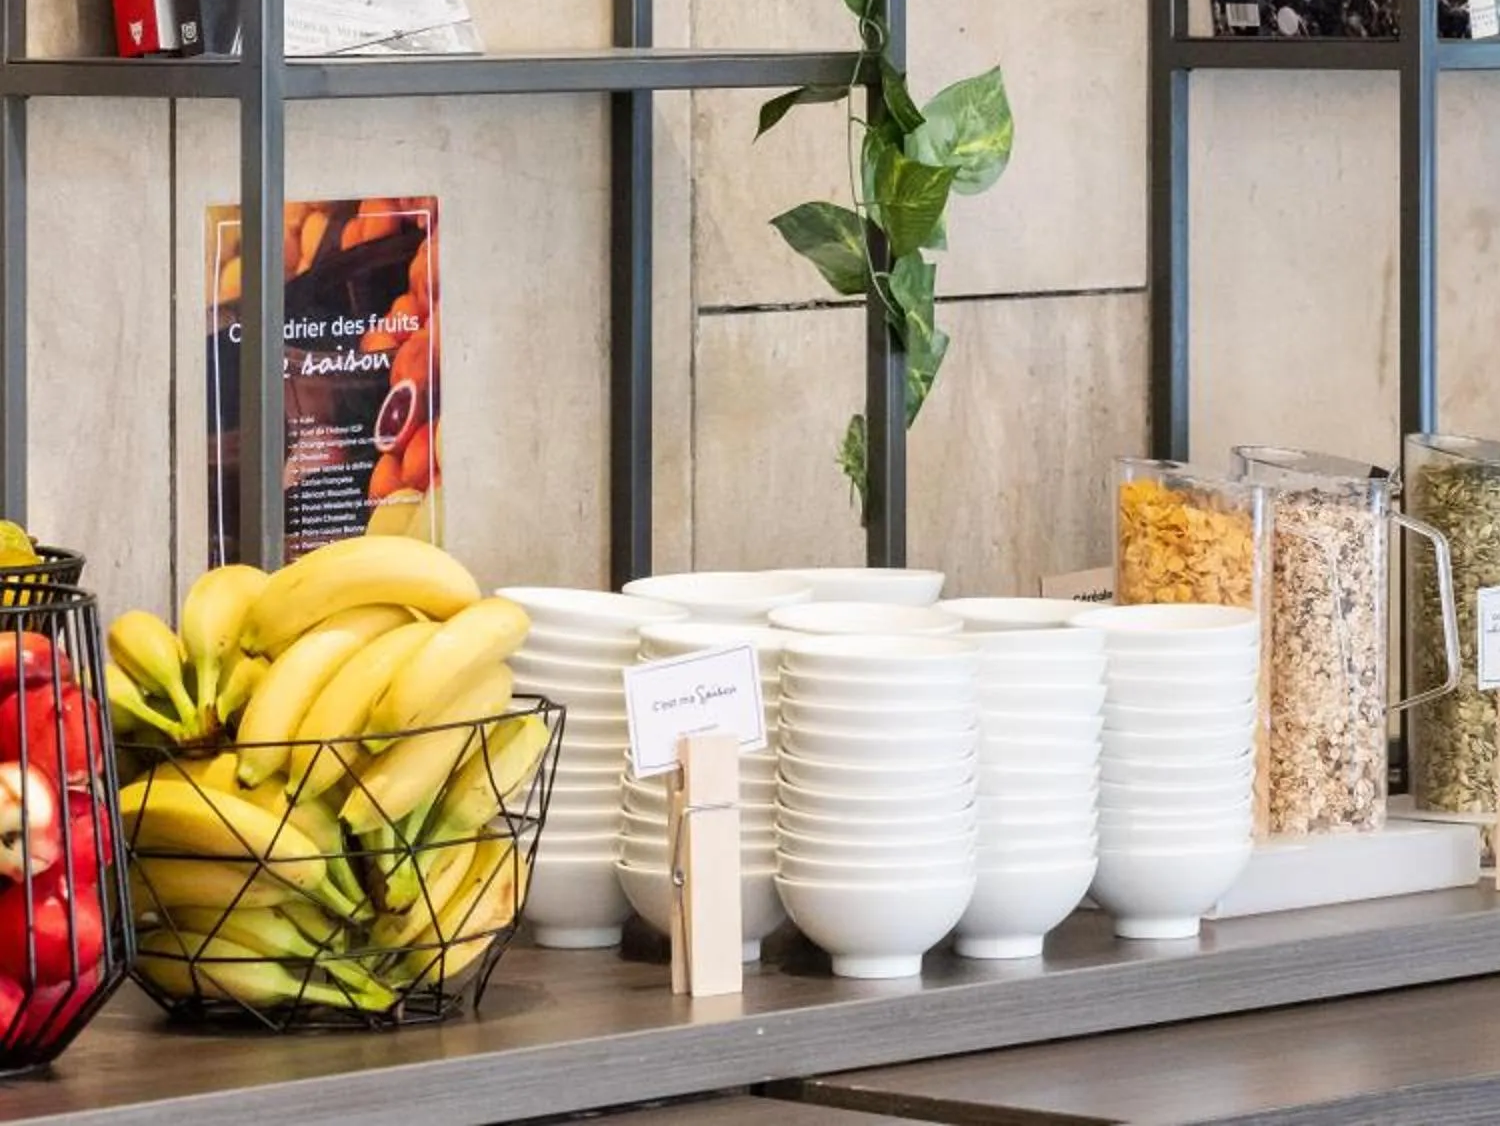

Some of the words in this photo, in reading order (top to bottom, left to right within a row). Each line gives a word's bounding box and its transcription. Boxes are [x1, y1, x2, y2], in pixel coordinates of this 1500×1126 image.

[229, 319, 327, 343] Cdrier
[331, 316, 365, 335] des
[369, 313, 420, 333] fruits
[301, 345, 391, 375] saison
